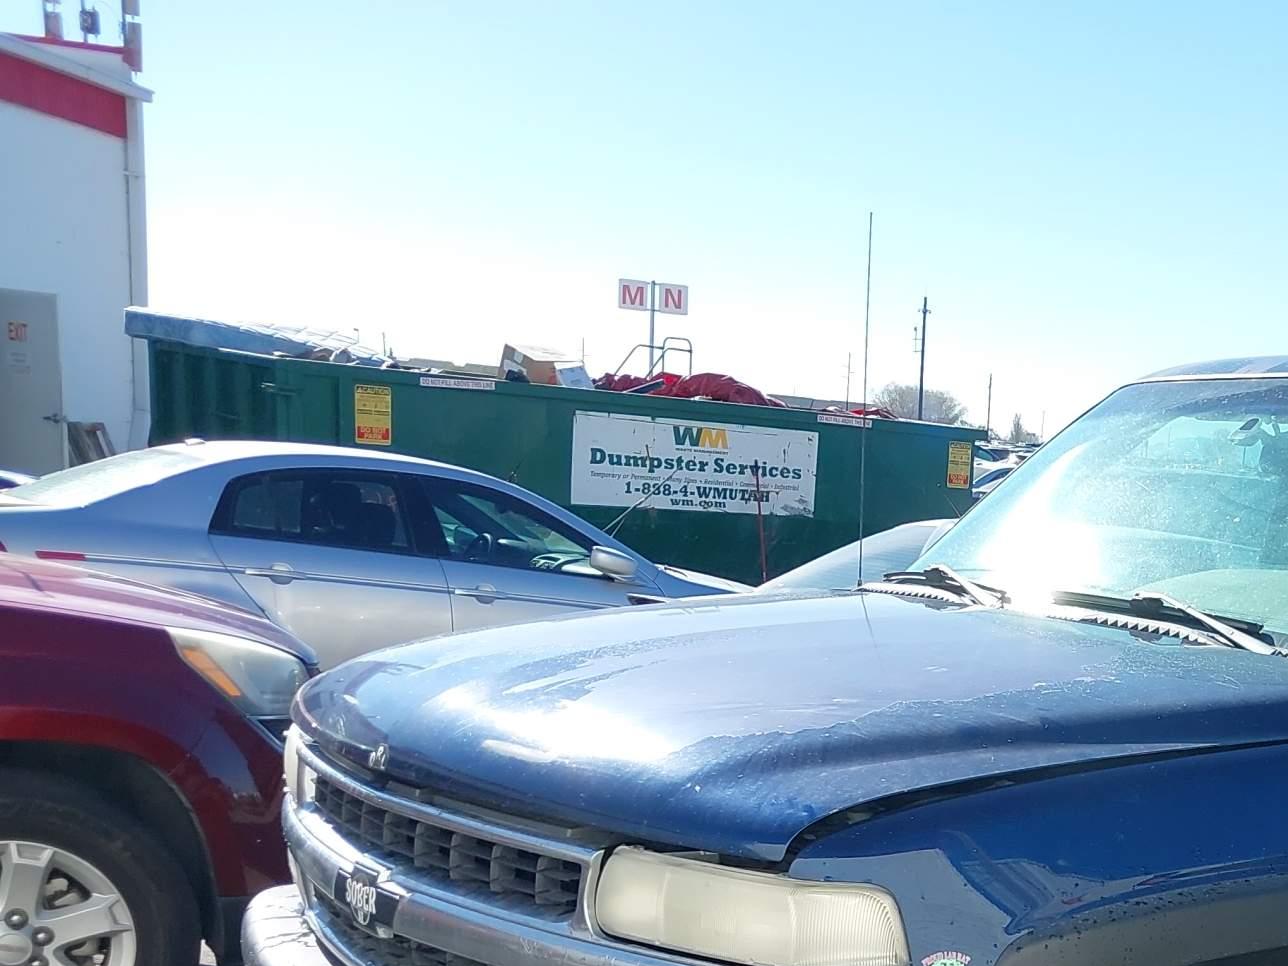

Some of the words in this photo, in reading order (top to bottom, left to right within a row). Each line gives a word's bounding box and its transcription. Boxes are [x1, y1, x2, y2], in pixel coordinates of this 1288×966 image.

[622, 285, 645, 306] M
[664, 288, 682, 309] N
[8, 322, 27, 341] EXIT
[672, 425, 729, 449] WM
[590, 447, 709, 473] Dumpster
[713, 457, 802, 480] Services
[670, 498, 727, 509] wm.com
[345, 878, 376, 914] SOBER
